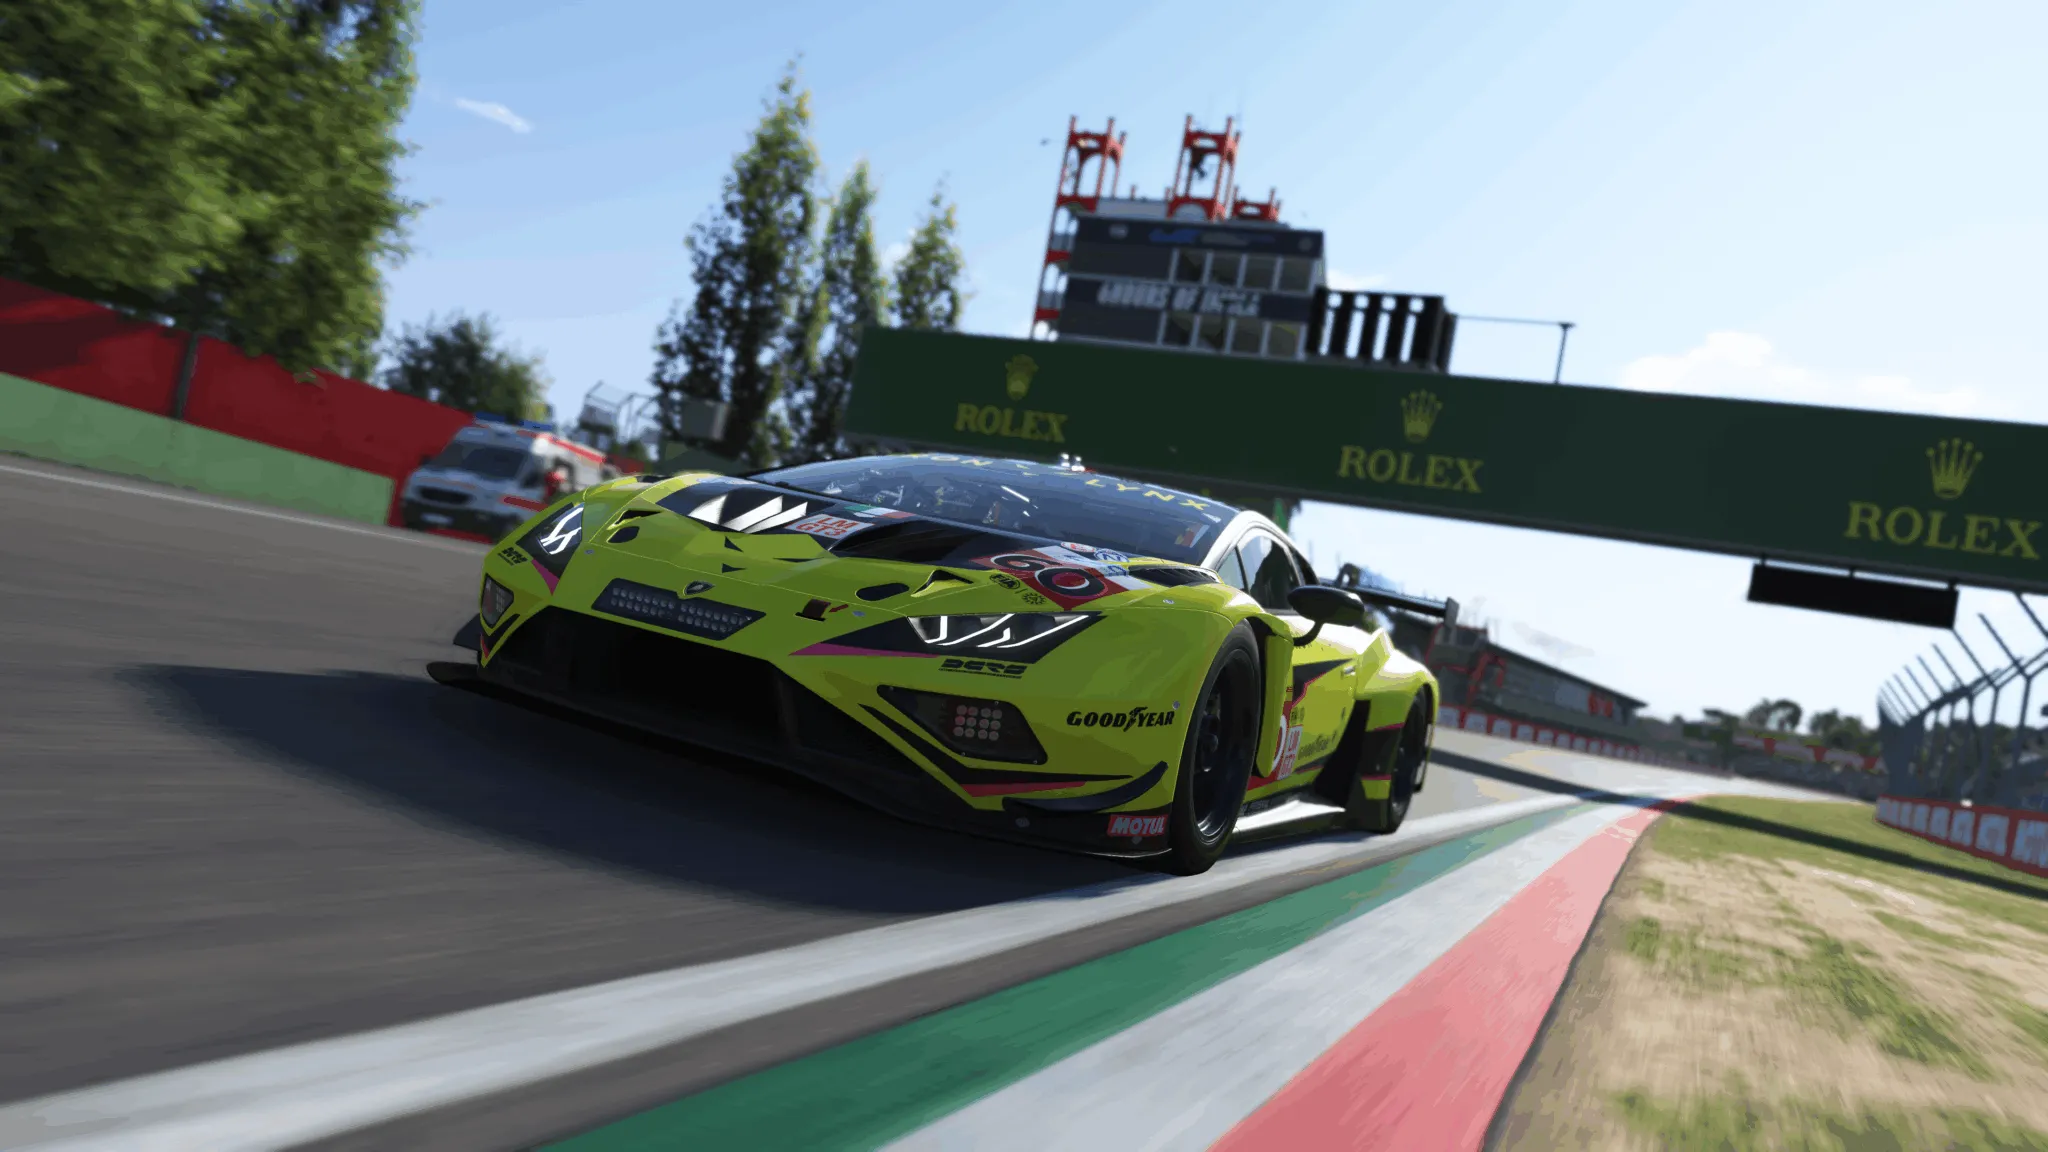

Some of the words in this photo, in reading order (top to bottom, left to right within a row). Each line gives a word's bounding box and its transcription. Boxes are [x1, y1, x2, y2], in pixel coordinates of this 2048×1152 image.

[955, 402, 1068, 443] ROLEX
[1338, 445, 1484, 493] ROLEX
[1085, 478, 1210, 510] LYNX
[796, 522, 847, 536] GT3
[818, 517, 860, 529] LM
[1845, 501, 2041, 559] ROLEX
[990, 553, 1108, 599] 60
[1066, 707, 1175, 732] GOODYEAR
[1110, 816, 1166, 835] MOTUL
